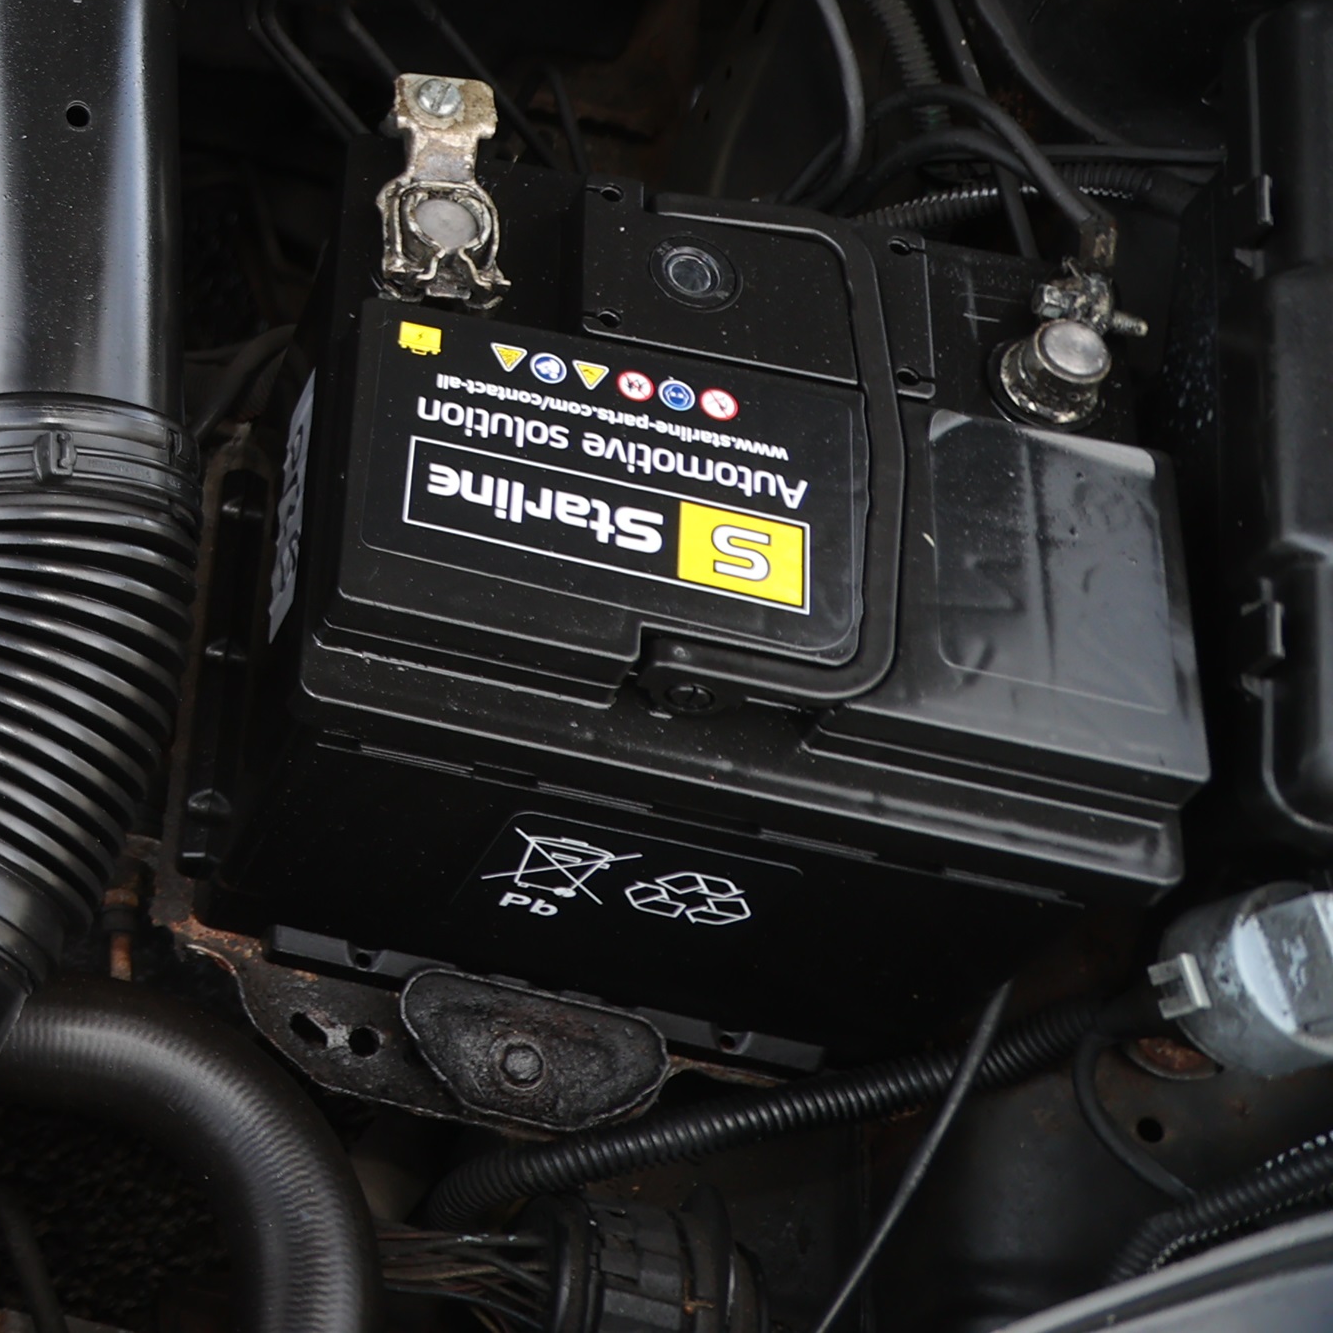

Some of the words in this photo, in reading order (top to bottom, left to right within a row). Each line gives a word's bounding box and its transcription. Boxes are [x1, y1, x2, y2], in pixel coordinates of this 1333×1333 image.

[417, 395, 570, 452] solution
[436, 373, 789, 462] www.starline-parts.com/contact-all
[582, 431, 809, 510] Automotive
[427, 463, 666, 554] Starline
[711, 524, 772, 582] S
[499, 891, 559, 917] Pb
